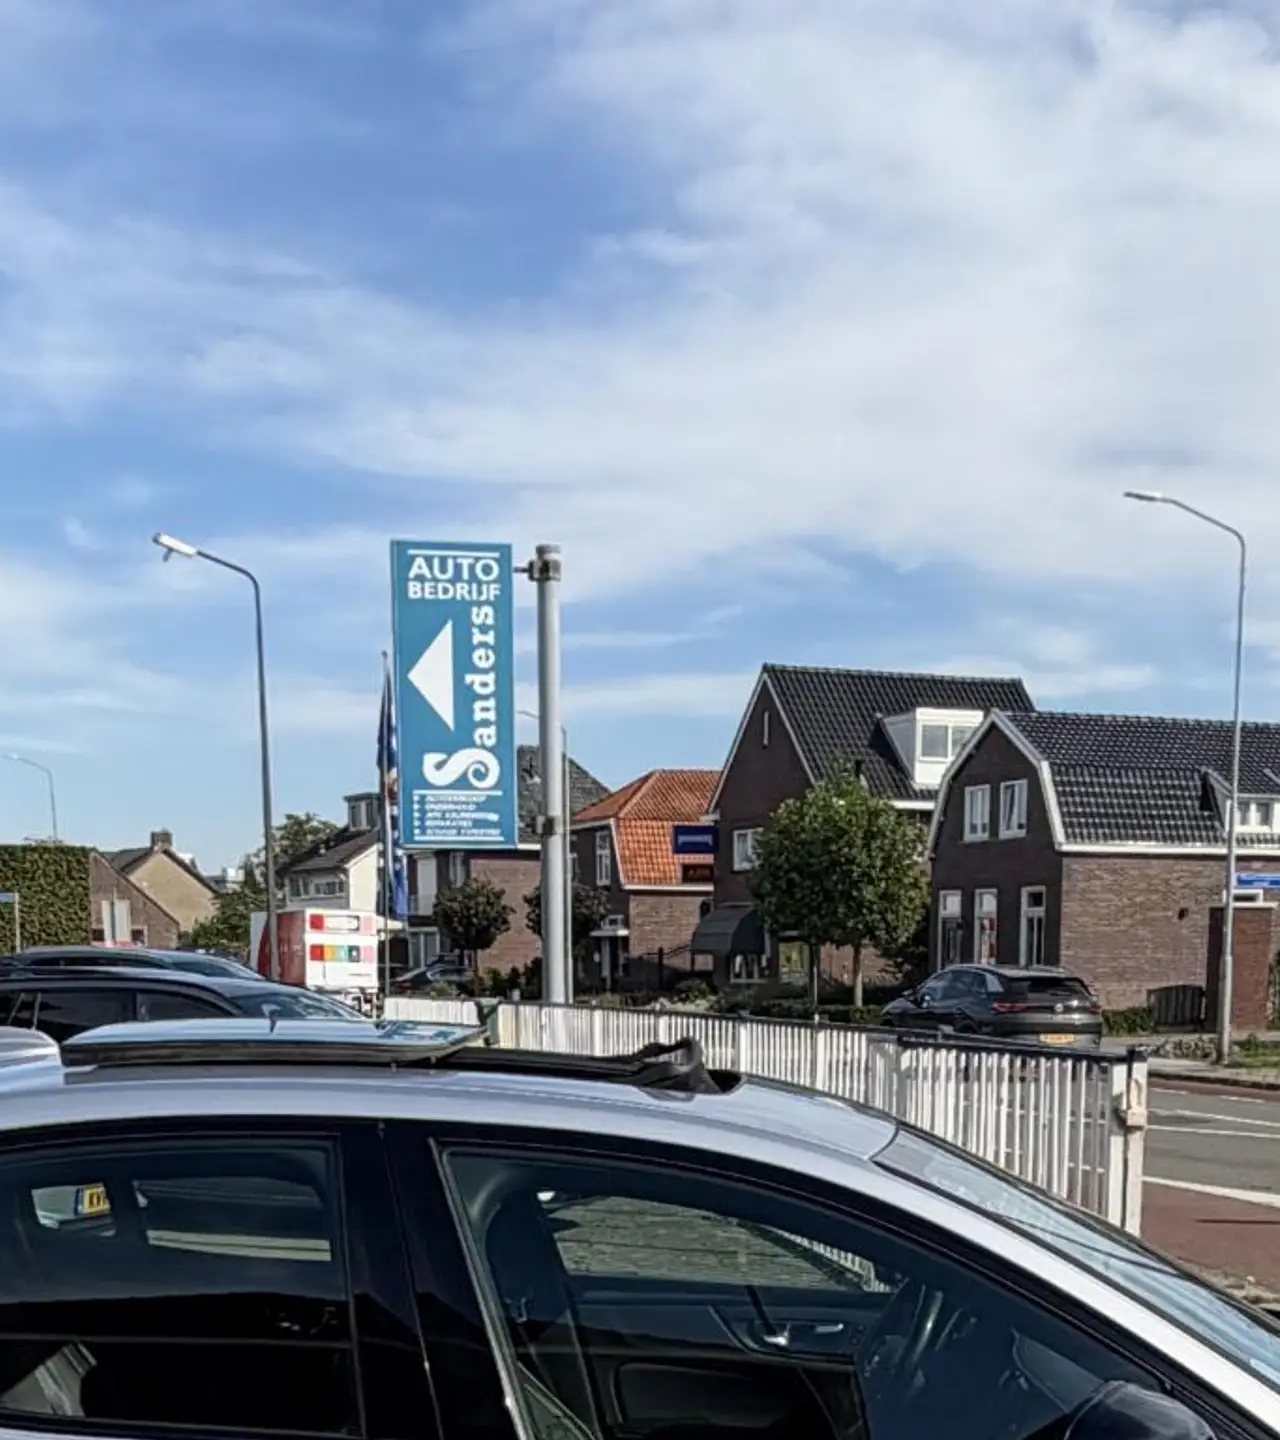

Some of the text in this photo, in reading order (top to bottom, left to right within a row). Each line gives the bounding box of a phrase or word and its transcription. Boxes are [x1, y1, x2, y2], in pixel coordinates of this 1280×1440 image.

[408, 556, 500, 581] AUTO
[407, 580, 501, 601] BEDRIJF
[422, 604, 500, 789] Sanders
